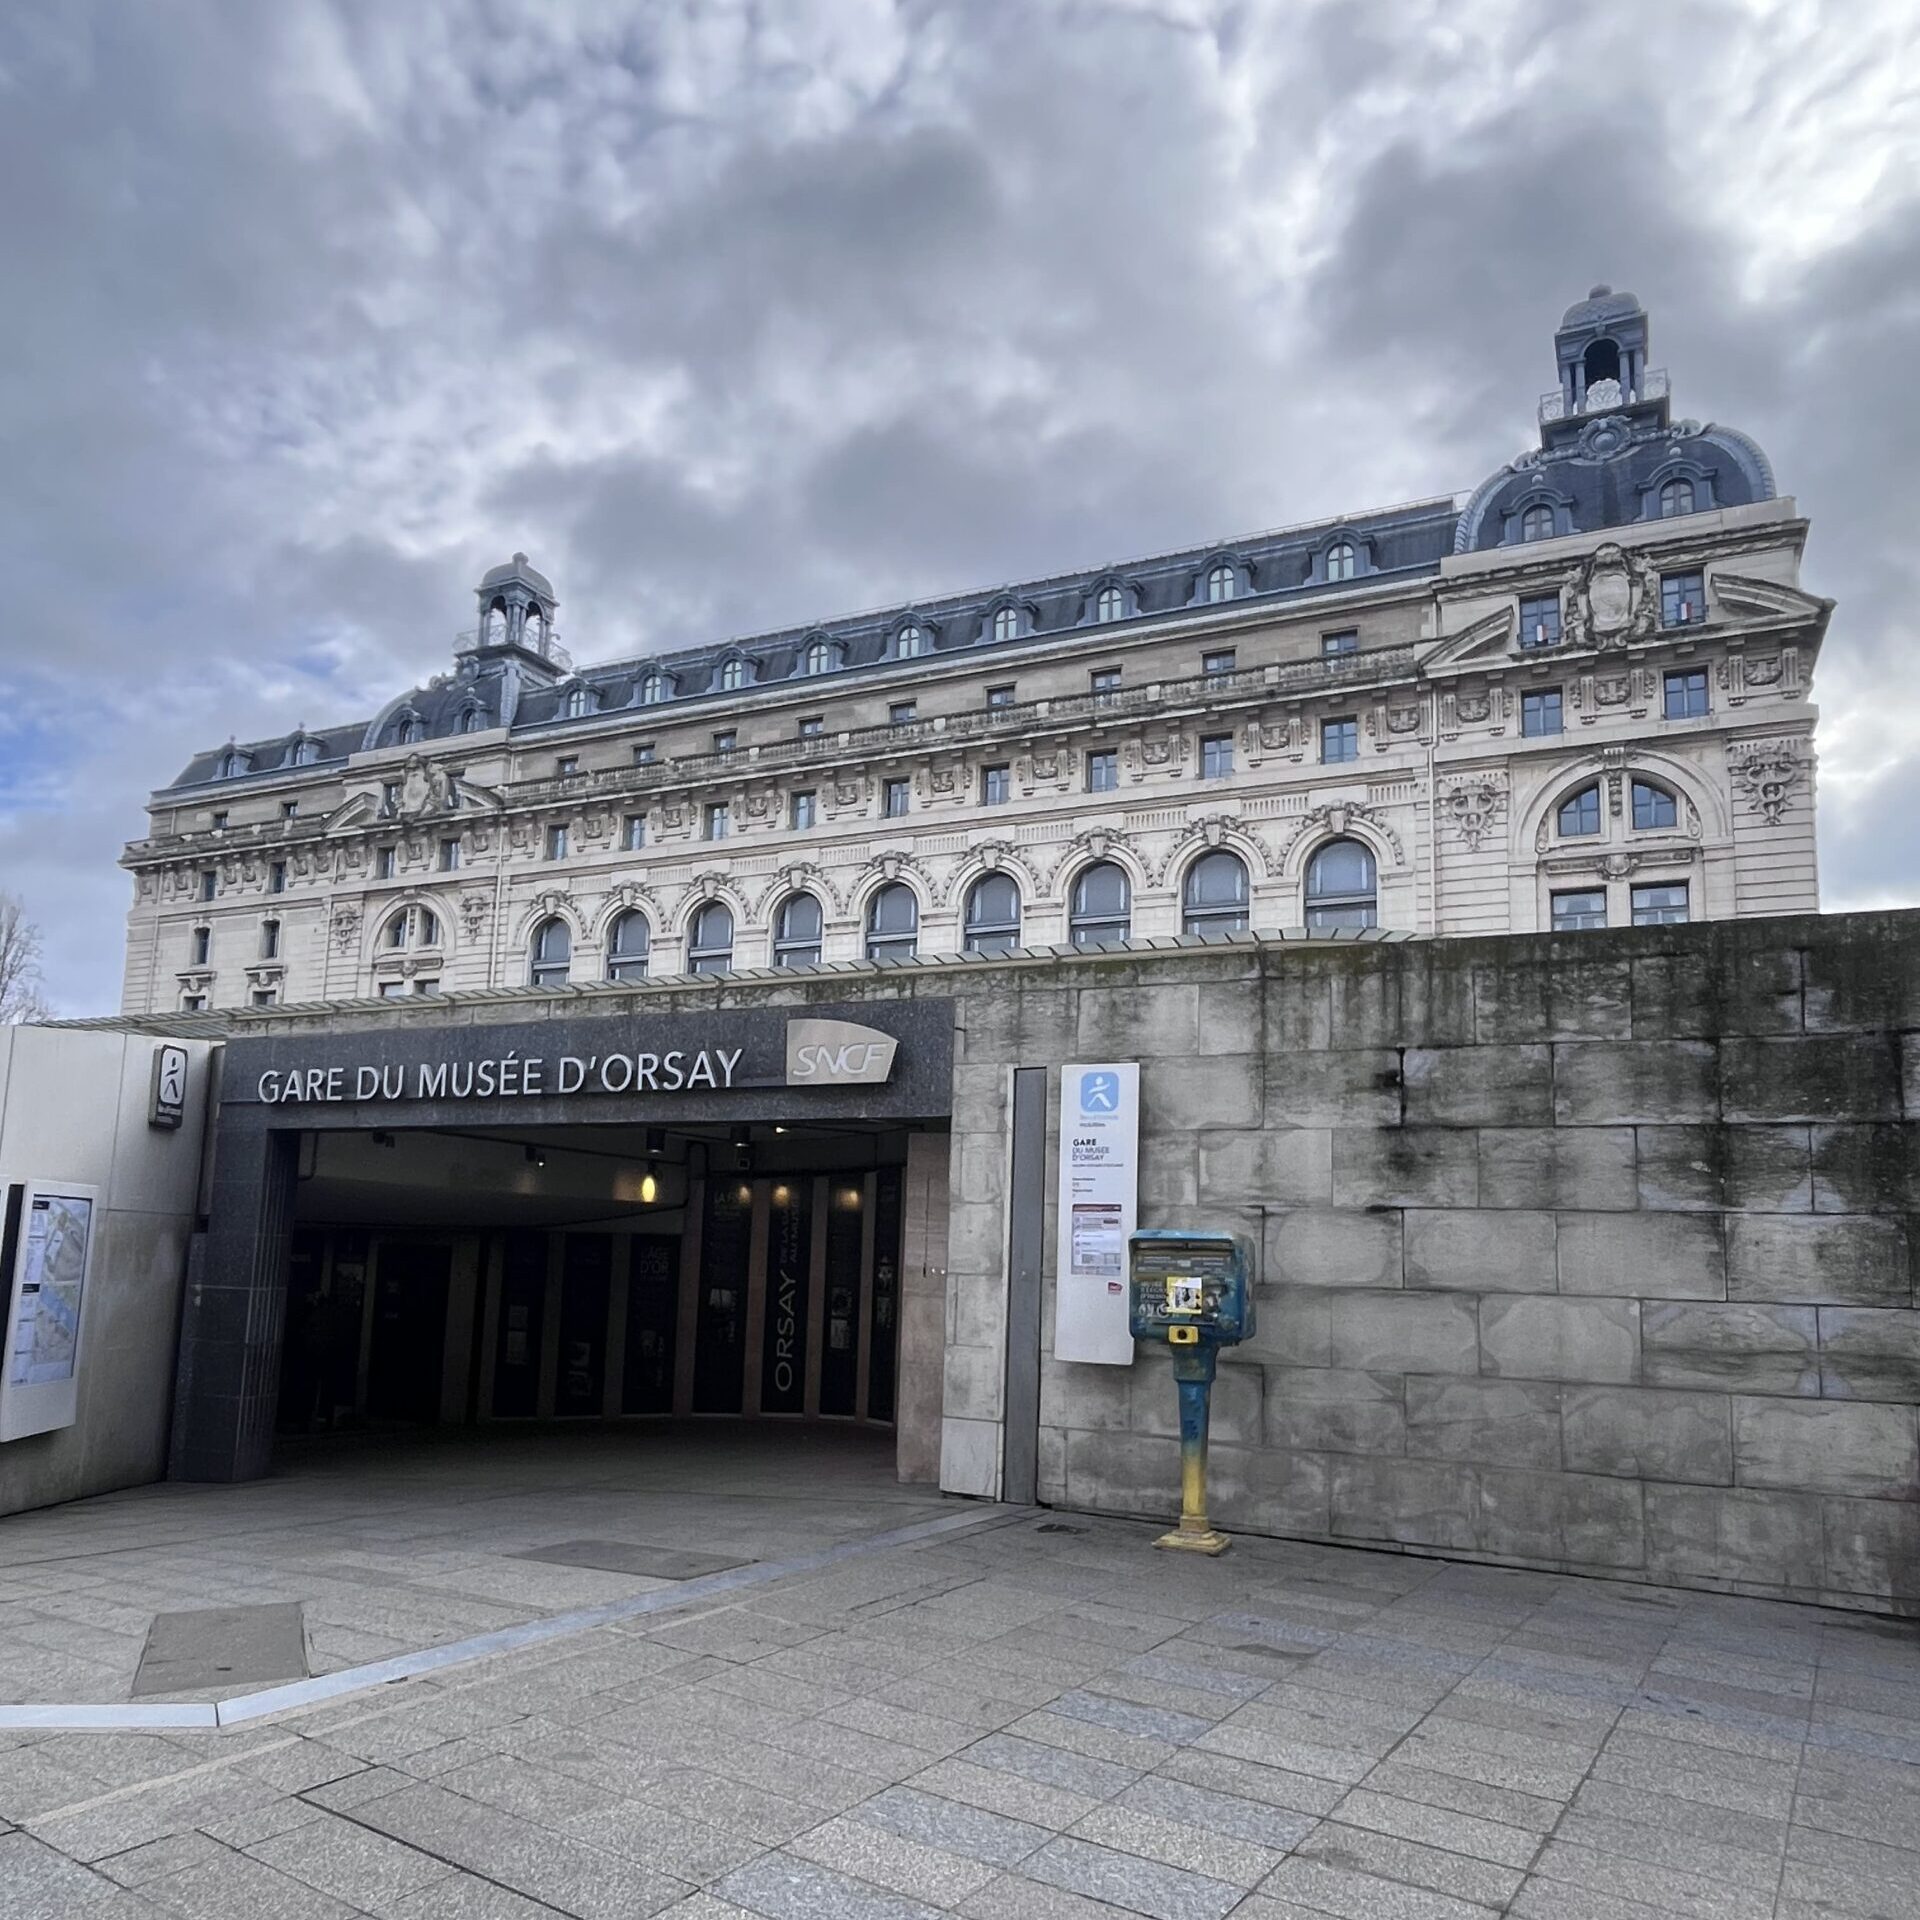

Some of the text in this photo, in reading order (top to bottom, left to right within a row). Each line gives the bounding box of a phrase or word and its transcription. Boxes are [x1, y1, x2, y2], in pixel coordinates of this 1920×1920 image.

[257, 1048, 743, 1103] GARE DU MUSÉE D'ORSAY
[792, 1043, 889, 1077] SNCF
[1072, 1138, 1097, 1147] GARE
[774, 1269, 797, 1392] ORSAY
